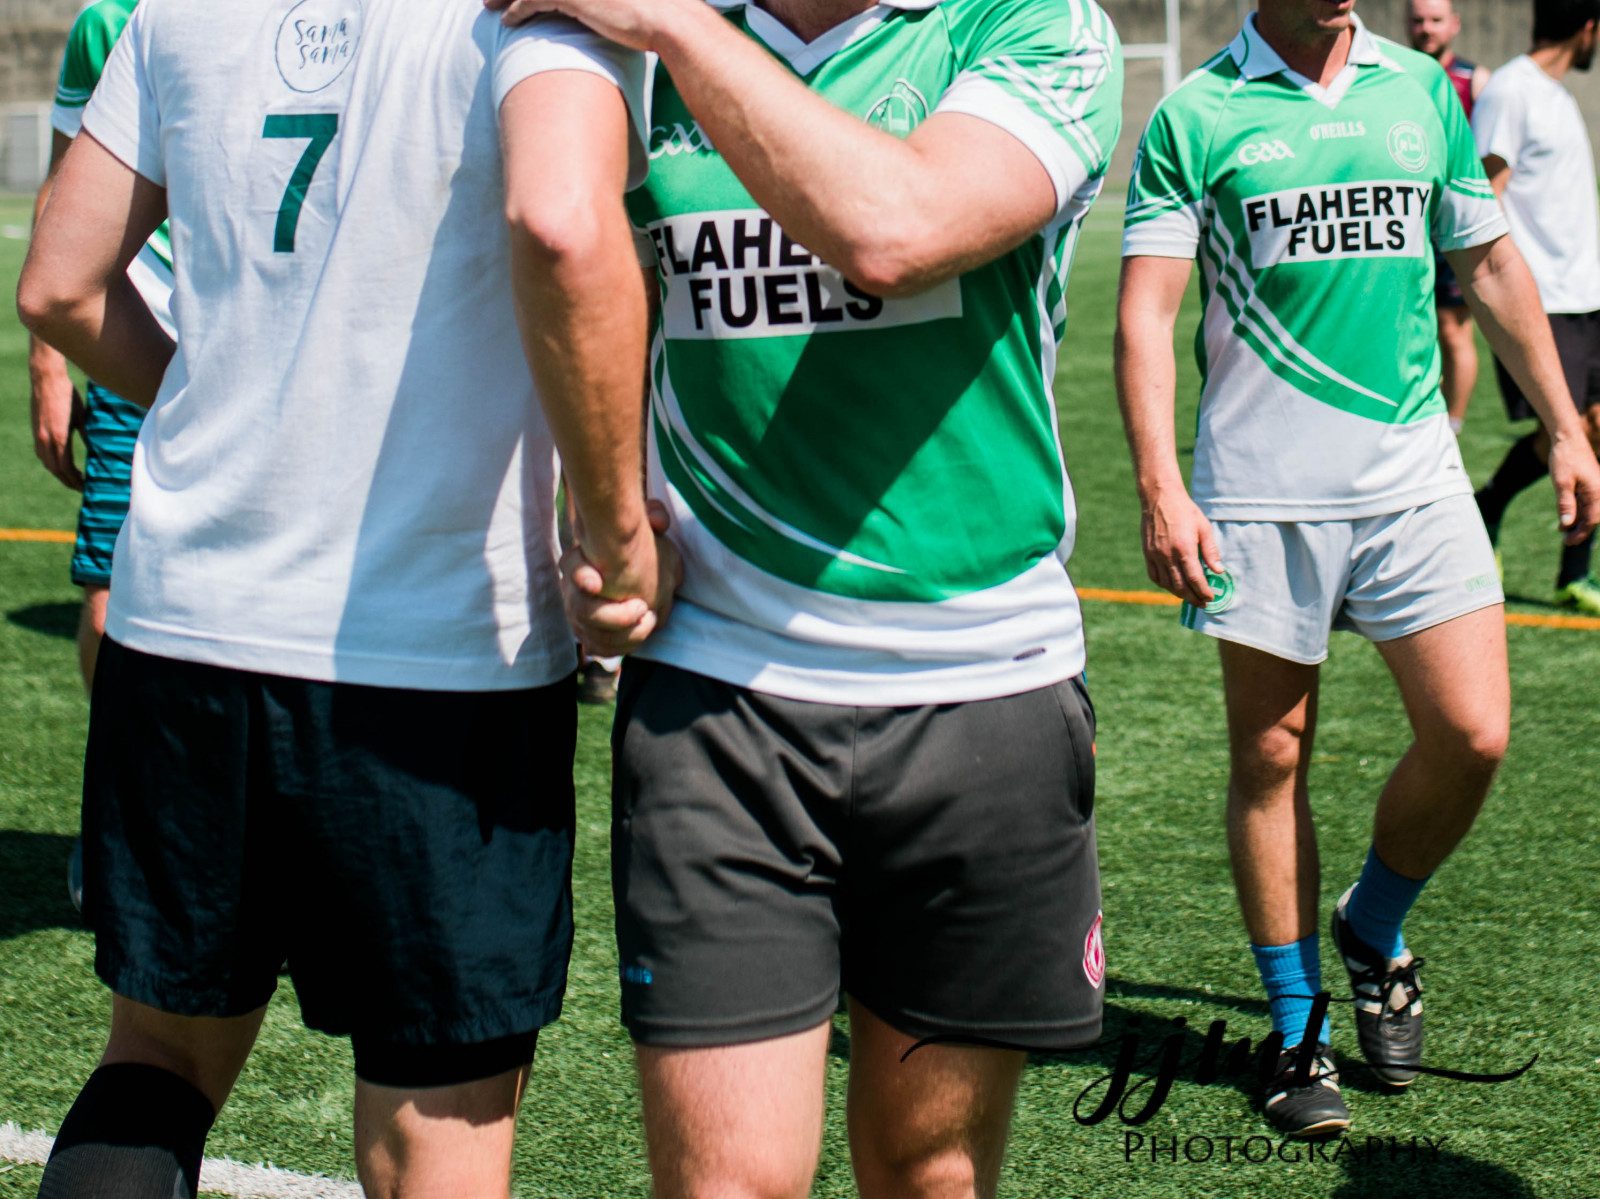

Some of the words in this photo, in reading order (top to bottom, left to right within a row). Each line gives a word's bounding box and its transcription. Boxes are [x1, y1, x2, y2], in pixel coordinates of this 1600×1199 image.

[262, 113, 339, 253] 7
[1246, 186, 1430, 232] FLAHERTY
[1288, 220, 1405, 257] FUELS
[688, 271, 884, 331] FUELS
